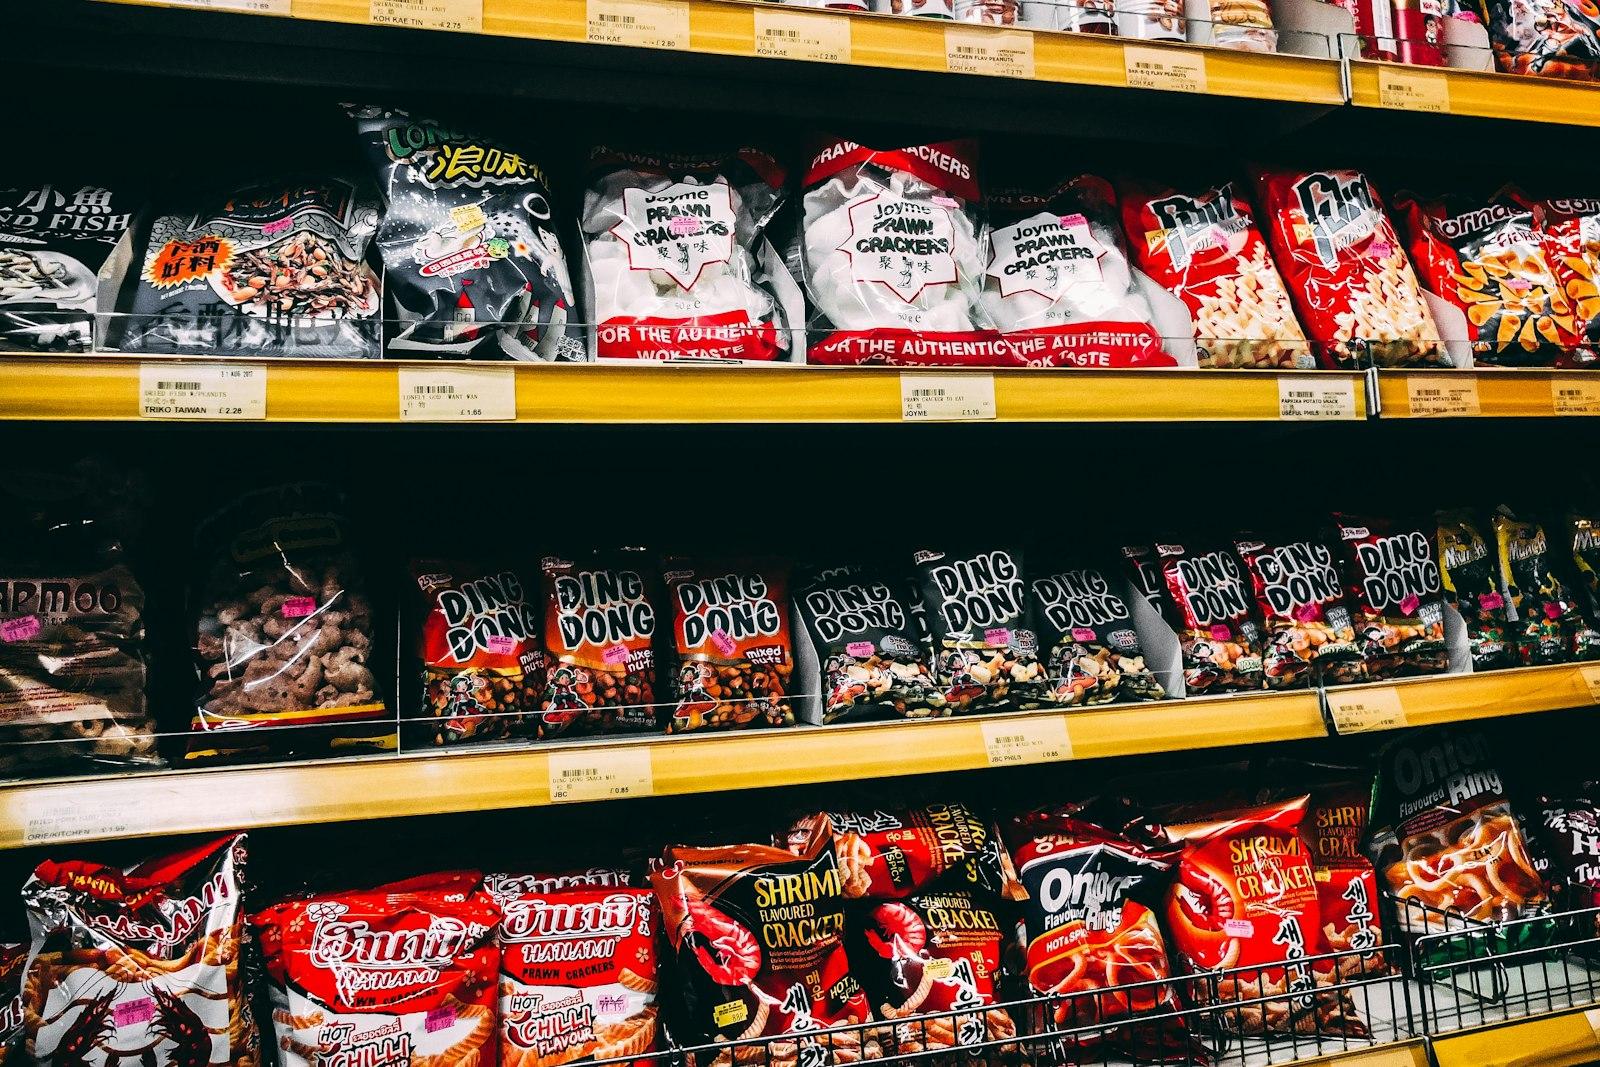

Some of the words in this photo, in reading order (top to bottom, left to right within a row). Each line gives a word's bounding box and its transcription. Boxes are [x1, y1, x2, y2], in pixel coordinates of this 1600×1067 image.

[373, 15, 391, 23] KOH
[411, 18, 424, 26] TIN
[644, 189, 710, 204] Joyme
[47, 212, 133, 233] FISH
[645, 203, 712, 226] PRAWN
[873, 203, 932, 220] Joyme
[872, 217, 934, 236] PRAWN
[693, 239, 710, 254] 味
[855, 237, 950, 256] CRACKERS
[1013, 234, 1076, 258] PRAWN
[917, 261, 933, 274] 味
[1003, 246, 1095, 277] CRACKERS
[600, 326, 631, 344] OR
[639, 327, 672, 344] THE
[856, 338, 888, 354] THE
[901, 339, 1008, 357] AUTHENTIC
[1013, 337, 1047, 353] THE
[1051, 333, 1155, 349] AUTHENTIC
[1058, 350, 1111, 367] TASTE
[174, 406, 207, 414] TAIWAN
[1254, 542, 1331, 585] DING
[1357, 531, 1431, 577] DING
[930, 550, 1018, 600] DING
[1177, 550, 1240, 593] DING
[554, 570, 644, 613] DING
[677, 573, 768, 616] DING
[1032, 569, 1108, 606] DING
[1264, 566, 1344, 617] DONG
[1363, 559, 1441, 610] DONG
[436, 571, 524, 628] DING
[805, 581, 890, 618] DING
[557, 601, 656, 651] DONG
[683, 598, 781, 649] DONG
[814, 598, 906, 645] DONG
[1044, 594, 1130, 633] DONG
[445, 602, 537, 664] DONG
[745, 645, 782, 660] mixed
[751, 655, 782, 666] nuts
[523, 659, 545, 675] nuts
[1448, 768, 1503, 806] Ring
[1399, 786, 1446, 818] Flavoured
[1315, 806, 1366, 828] SHRI
[27, 829, 90, 840] ORIE/KITCHEN
[925, 803, 966, 870] CRACKE
[1317, 826, 1361, 838] FLAVOURE
[889, 844, 906, 867] HOT
[1228, 836, 1301, 864] SHRIM
[1317, 836, 1362, 860] CRAC
[884, 851, 902, 883] SPICY
[1039, 862, 1126, 913] Onion
[759, 903, 815, 923] FLAVOURED
[1085, 904, 1123, 935] Rings
[762, 911, 844, 950] CRACKER
[521, 938, 616, 964] HANAMI
[335, 969, 440, 991] HANAMI
[521, 966, 560, 981] PRAWN
[565, 960, 615, 981] CRACKERS
[829, 975, 850, 999] HOT
[511, 996, 542, 1013] HOT
[319, 1026, 350, 1044] HOT
[523, 1006, 594, 1043] CHILLI
[330, 1033, 411, 1067] CHILLI
[537, 1026, 597, 1056] FLAVOUR
